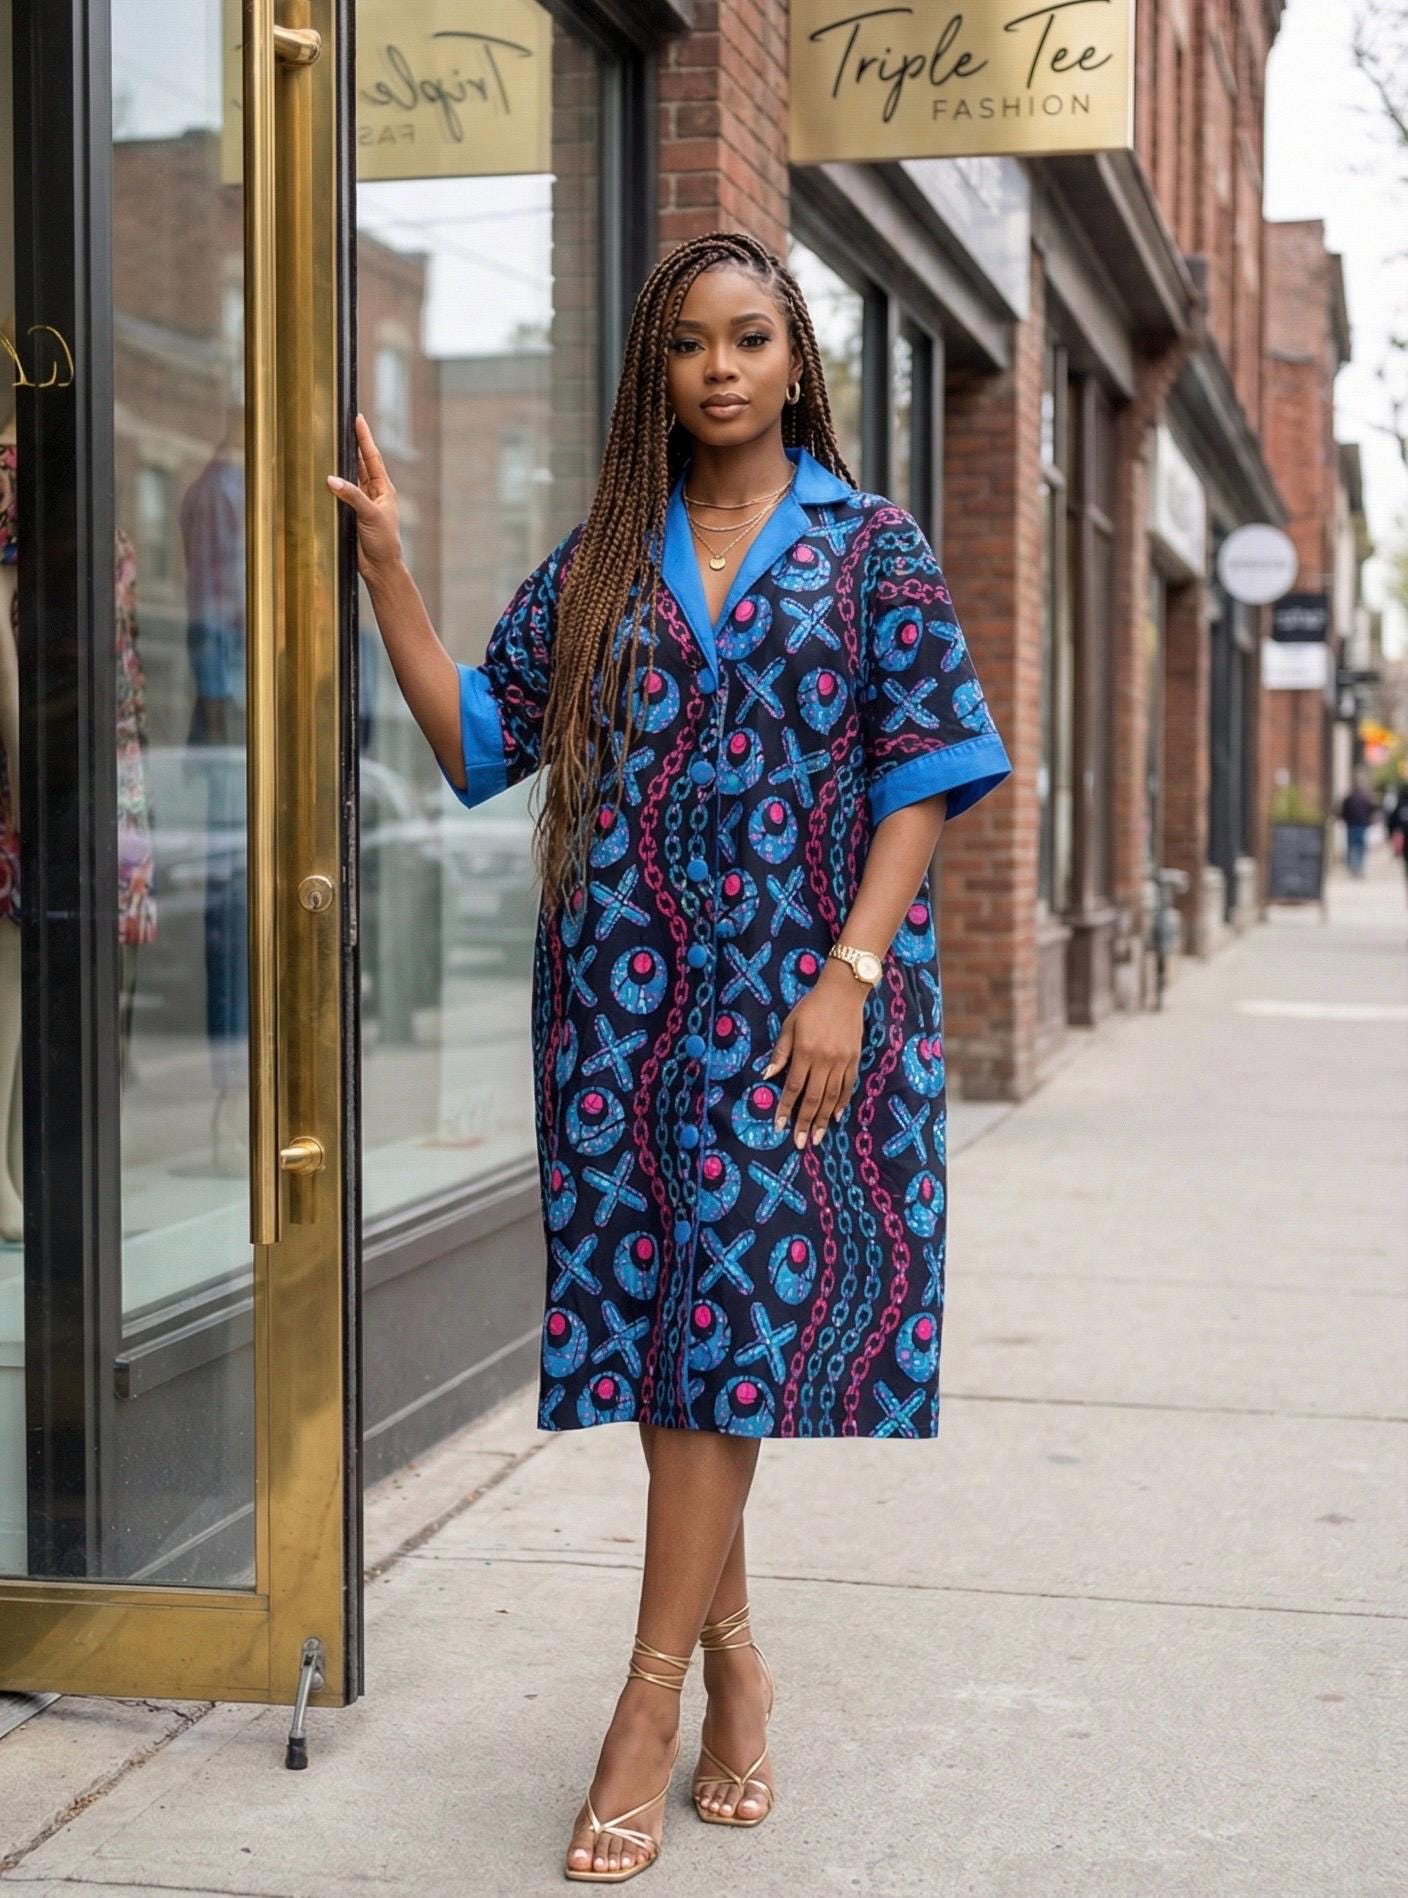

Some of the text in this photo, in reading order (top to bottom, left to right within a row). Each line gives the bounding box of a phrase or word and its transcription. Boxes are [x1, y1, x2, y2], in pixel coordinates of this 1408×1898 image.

[809, 0, 1113, 124] Triple Tee
[931, 94, 1091, 121] FASHION
